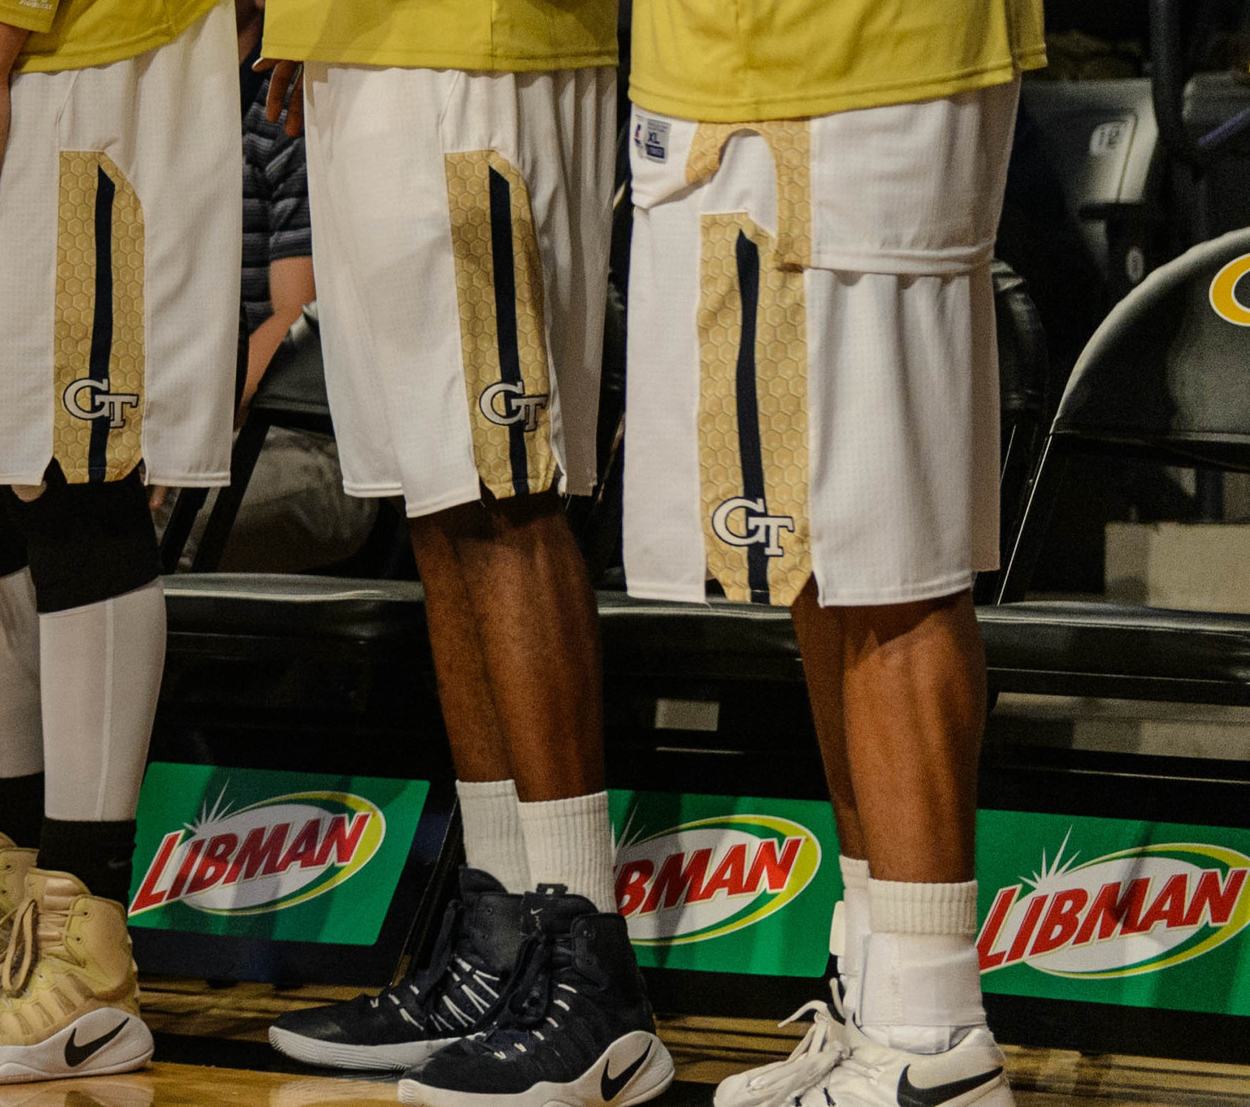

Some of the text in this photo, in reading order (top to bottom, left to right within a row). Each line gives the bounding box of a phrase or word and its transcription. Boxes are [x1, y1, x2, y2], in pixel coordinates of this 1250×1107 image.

[129, 812, 372, 915] LIBMAN
[613, 836, 806, 919] BMAN
[976, 867, 1250, 973] LIBMAN
